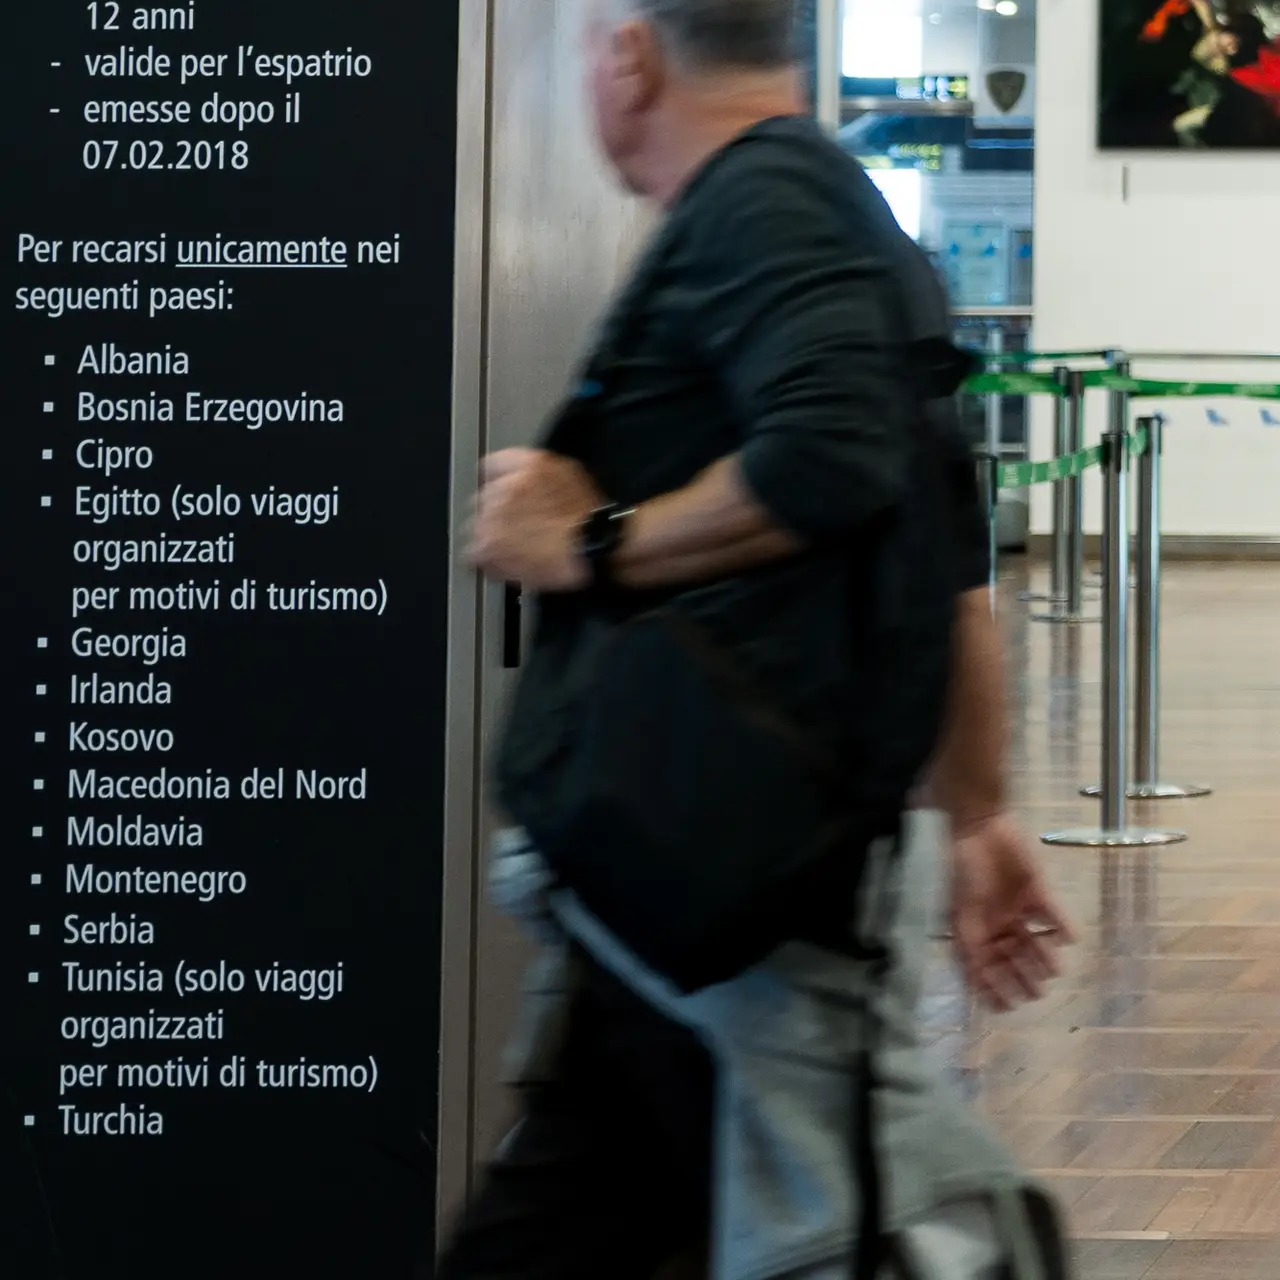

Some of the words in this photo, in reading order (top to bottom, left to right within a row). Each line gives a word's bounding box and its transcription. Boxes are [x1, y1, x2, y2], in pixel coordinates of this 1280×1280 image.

[87, 1, 120, 30] 12
[132, 0, 195, 30] anni
[84, 45, 171, 77] valide
[180, 54, 228, 85] per
[83, 100, 191, 123] emesse
[200, 91, 275, 132] dopo
[285, 91, 300, 123] il
[82, 140, 249, 170] 07.02.2018
[18, 233, 63, 263] Per
[72, 232, 166, 263] recarsi
[175, 232, 348, 268] unicamente
[357, 233, 400, 264] nei
[15, 279, 139, 318] seguenti
[149, 279, 233, 318] paesi:
[77, 342, 189, 375] Albania
[78, 391, 174, 422] Bosnia
[186, 391, 344, 430] Erzegovina
[76, 438, 153, 477] Cipro
[75, 485, 161, 524] Egitto
[171, 483, 241, 521] (solo
[250, 485, 339, 525] viaggi
[73, 532, 235, 571] organizzati
[72, 587, 120, 618] per
[129, 579, 220, 610] motivi
[230, 578, 256, 610] di
[266, 578, 388, 616] turismo)
[71, 626, 186, 666] Georgia
[70, 672, 172, 704] Irlanda
[69, 721, 174, 752] Kosovo
[68, 766, 230, 799] Macedonia
[240, 767, 284, 799] del
[296, 767, 367, 800] Nord
[67, 814, 203, 847] Moldavia
[66, 863, 247, 902] Montenegro
[63, 912, 154, 944] Serbia
[61, 961, 163, 992] Tunisia
[175, 959, 245, 997] (solo
[254, 961, 343, 1001] viaggi
[60, 1008, 224, 1048] organizzati
[59, 1064, 108, 1096] per
[117, 1056, 209, 1087] motivi
[219, 1055, 246, 1087] di
[255, 1055, 378, 1093] turismo)
[57, 1102, 163, 1135] Turchia
